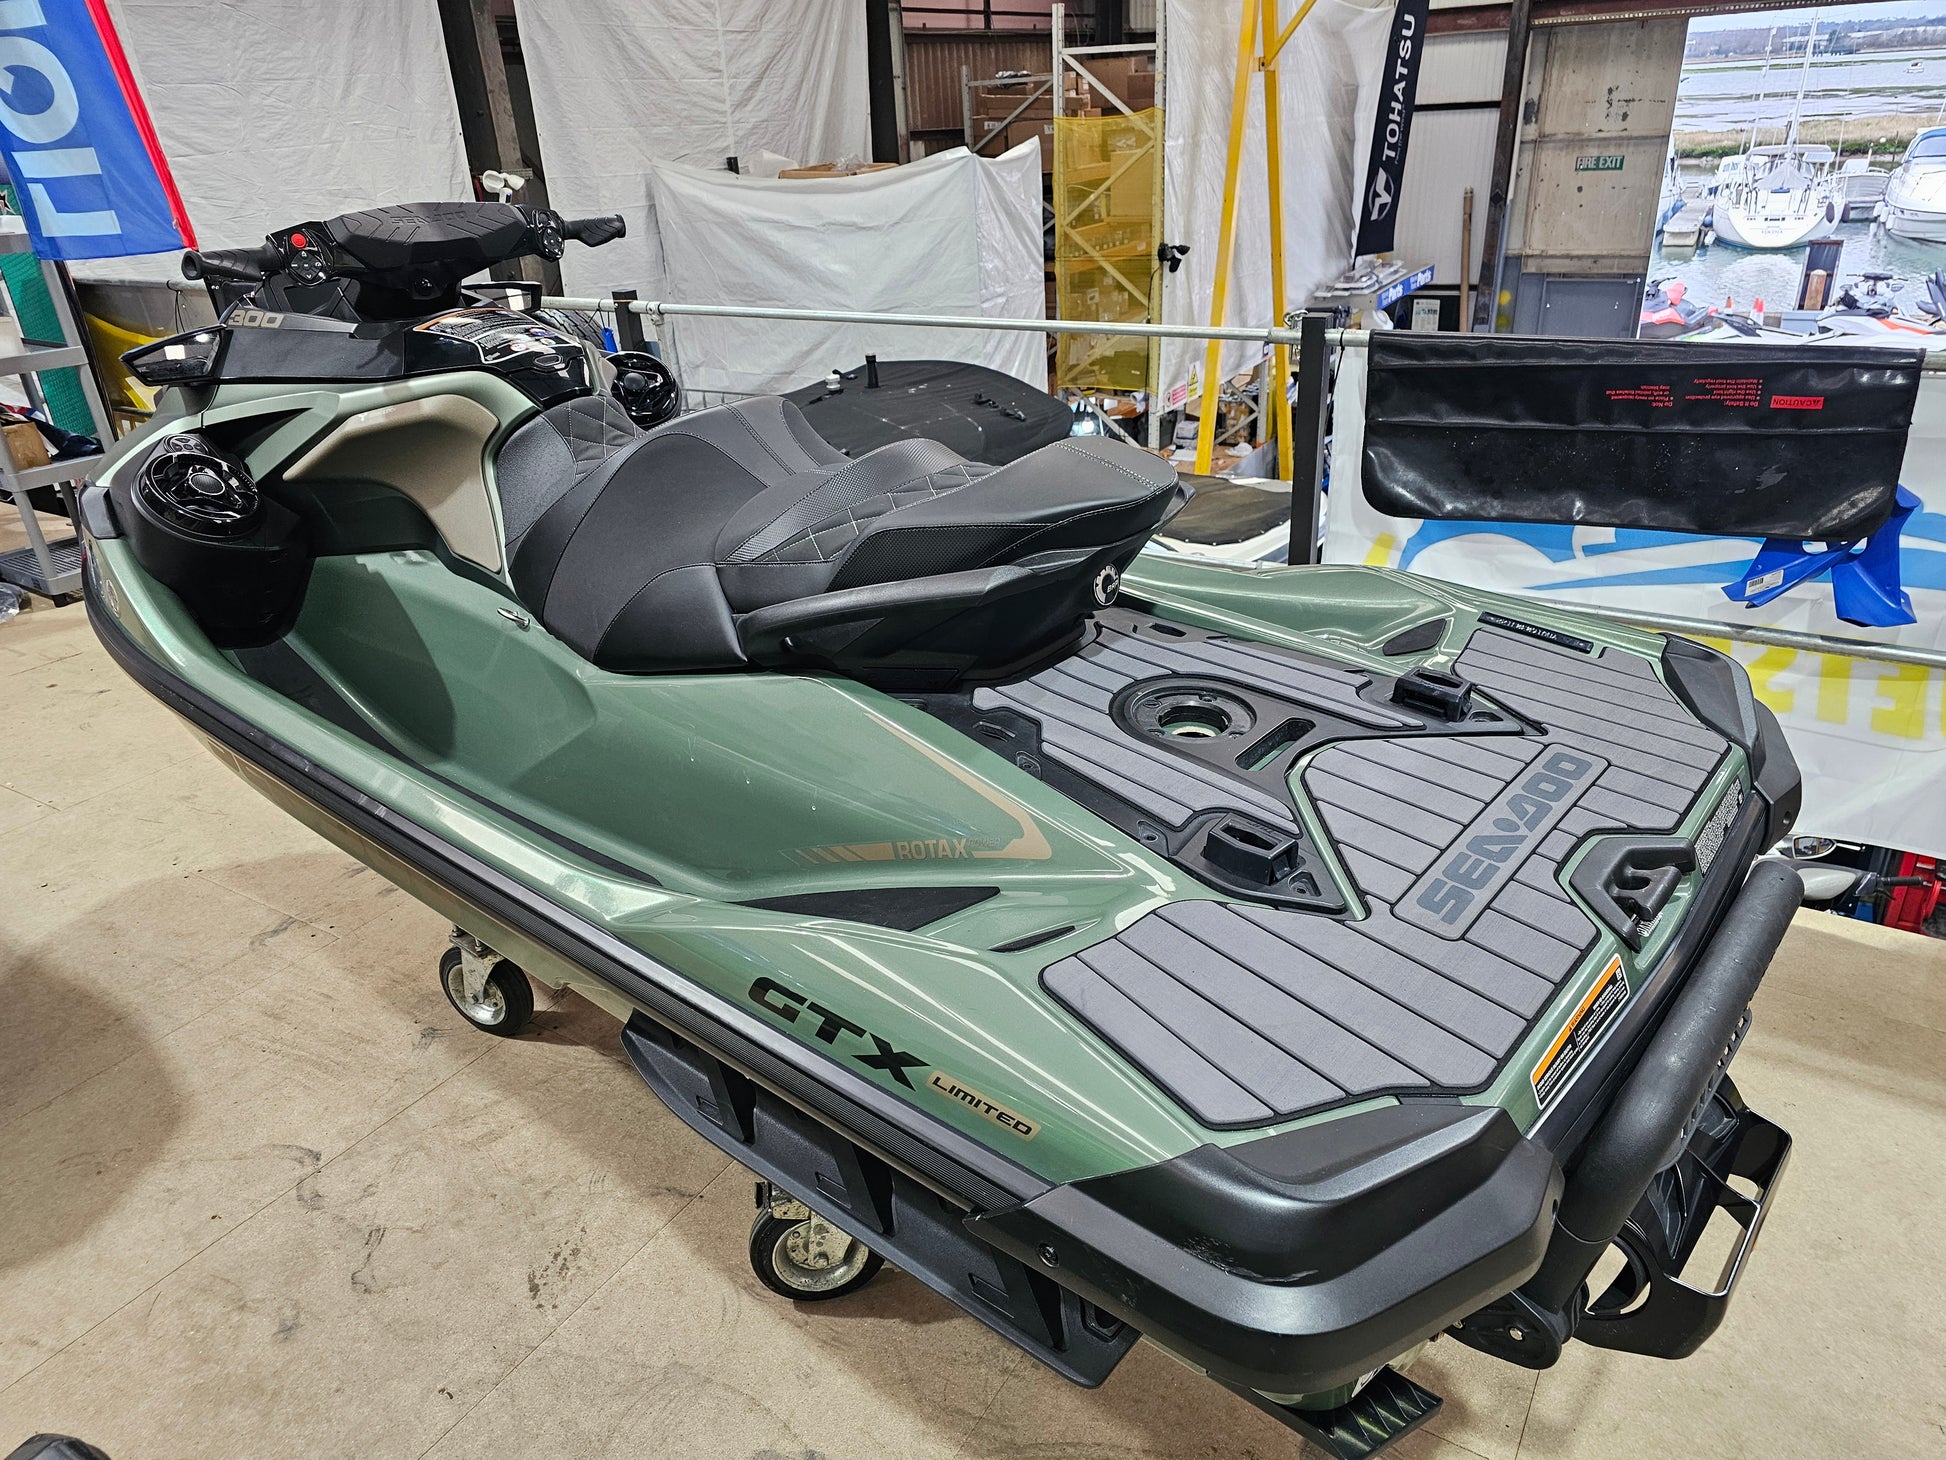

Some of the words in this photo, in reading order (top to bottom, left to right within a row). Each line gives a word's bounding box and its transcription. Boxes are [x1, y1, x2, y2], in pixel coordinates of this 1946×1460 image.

[1383, 14, 1416, 161] TOHATSU
[1577, 157, 1597, 169] FIRE
[1599, 156, 1623, 168] EXIT
[228, 309, 284, 328] 300
[1773, 398, 1812, 407] CAUTION
[897, 838, 969, 860] ROTAX
[748, 976, 932, 1092] GTX
[931, 1076, 1034, 1136] LIMITED
